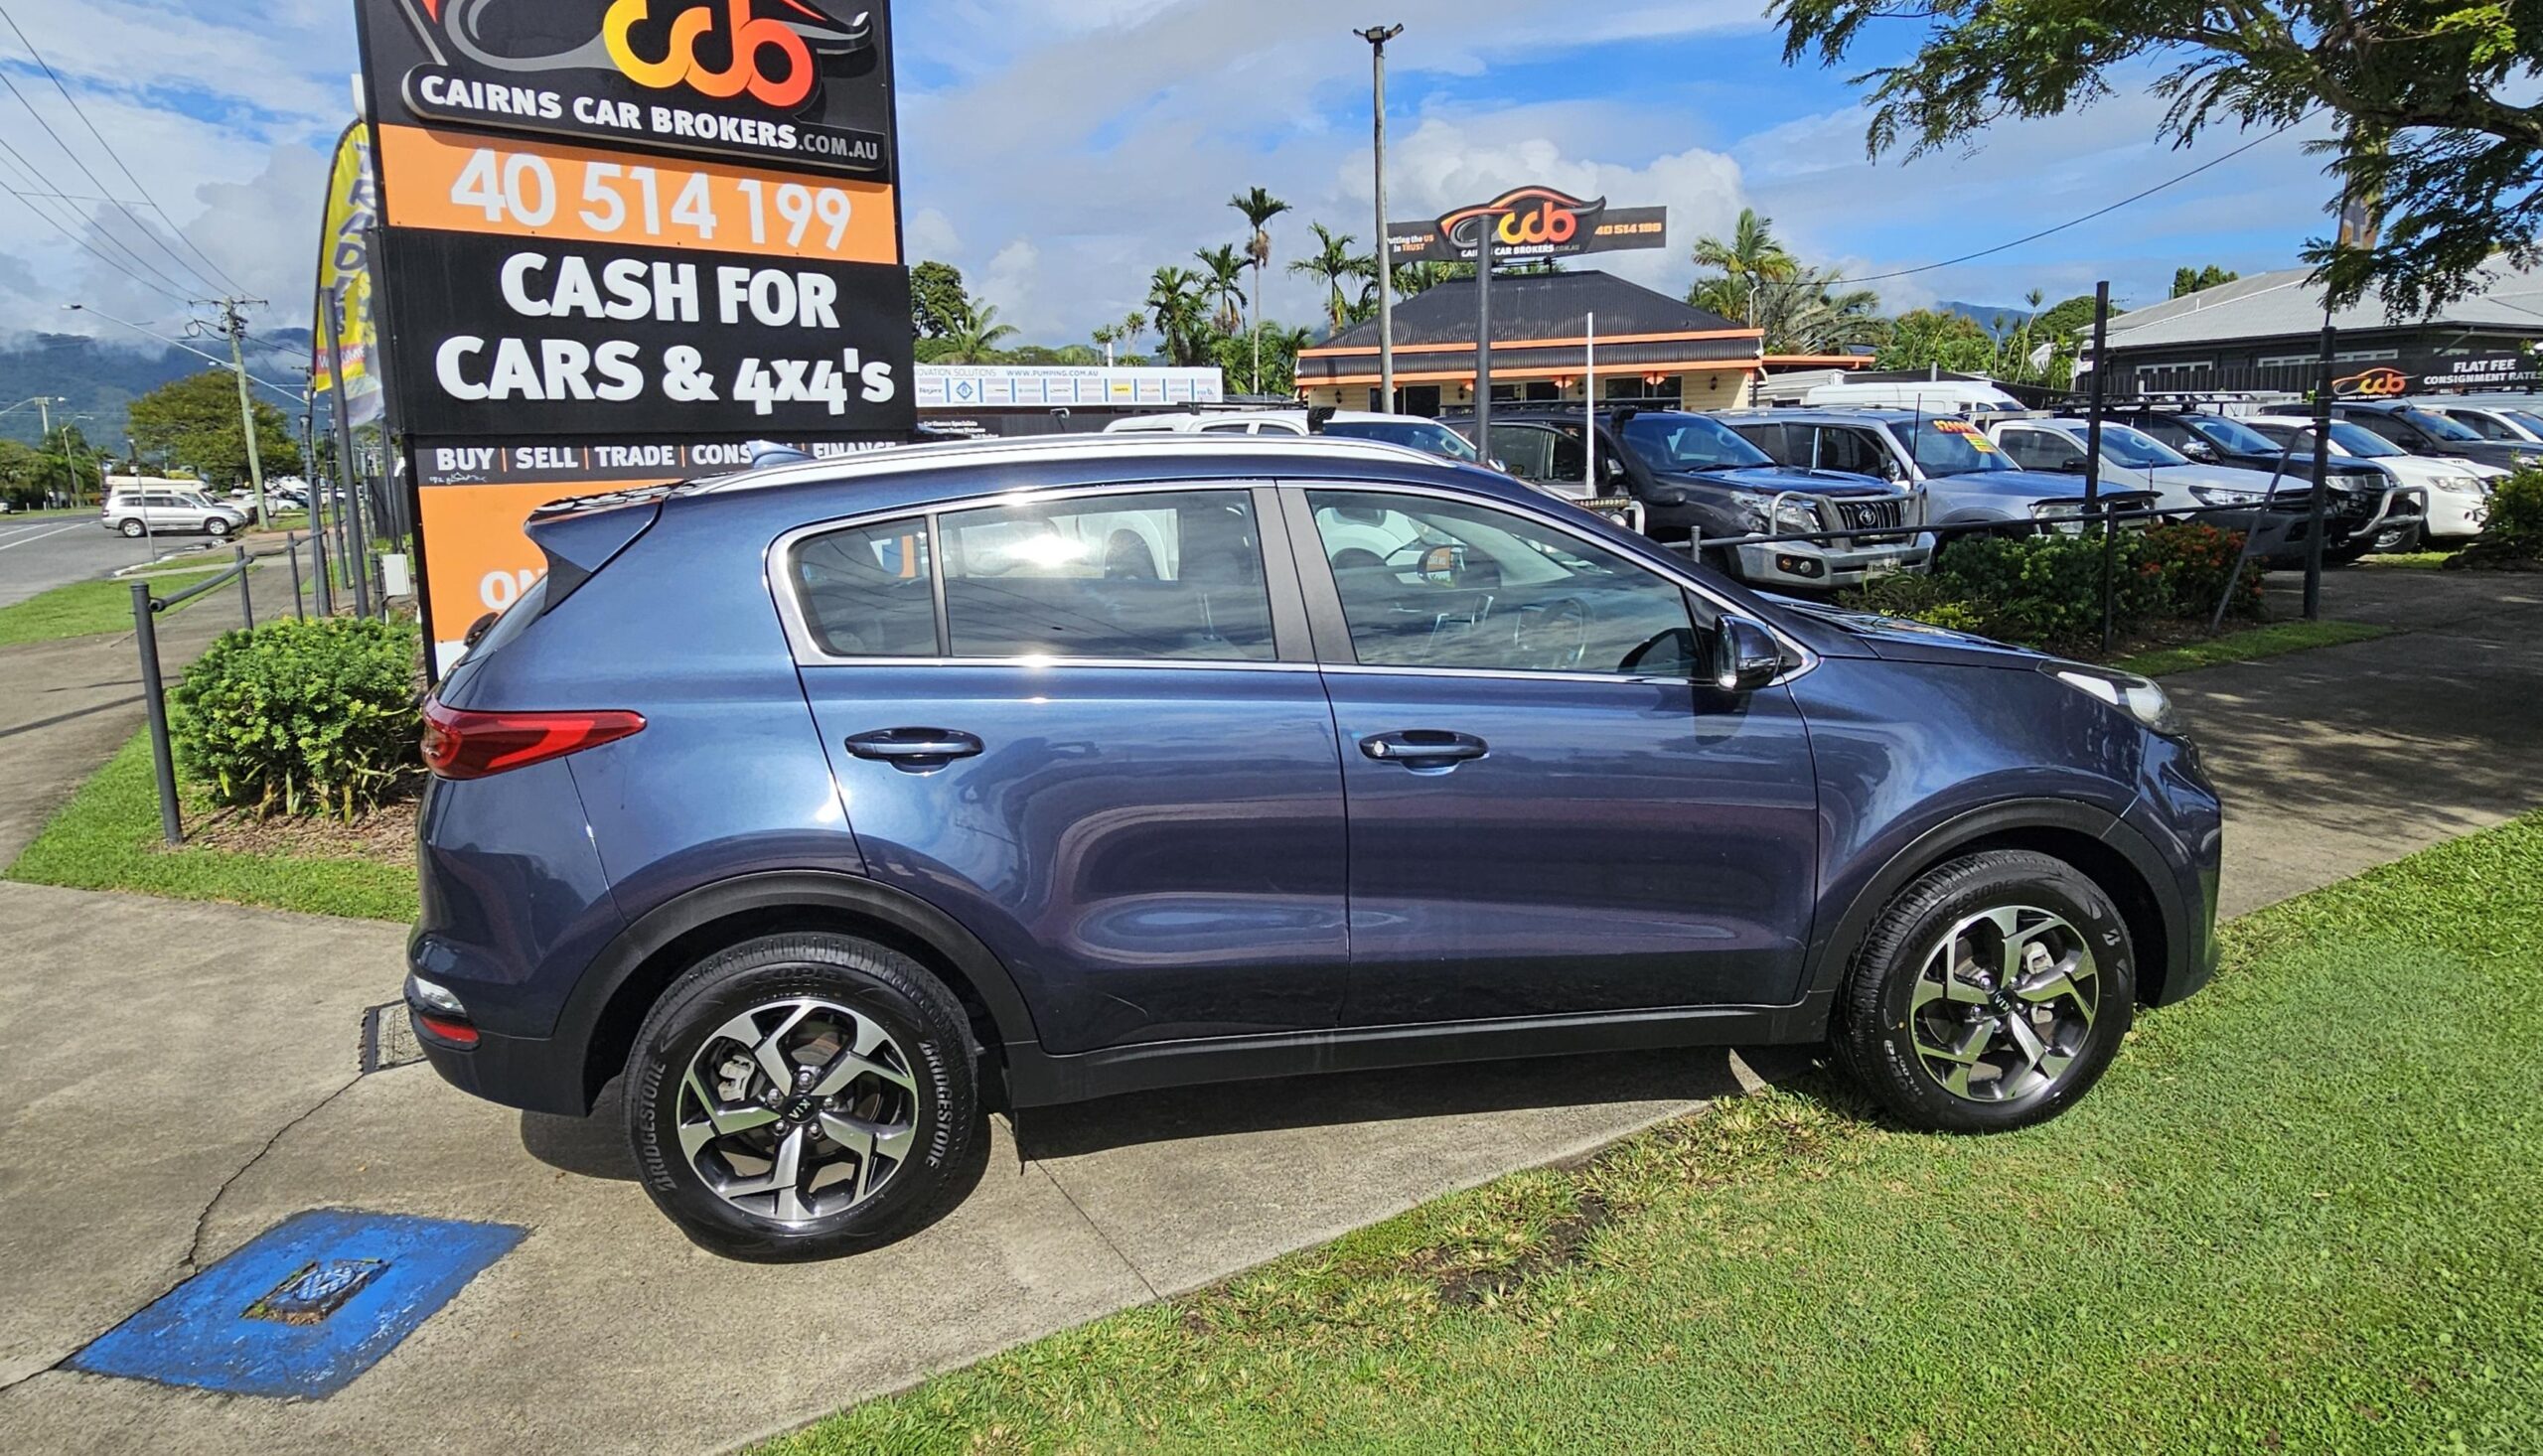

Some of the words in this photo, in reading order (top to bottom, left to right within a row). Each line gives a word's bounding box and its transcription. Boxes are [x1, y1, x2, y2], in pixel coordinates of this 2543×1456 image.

[420, 75, 562, 119] CAIRNS
[573, 96, 643, 130] CAR
[450, 147, 556, 227] 40
[578, 161, 718, 239] 514
[737, 179, 852, 251] 199
[1411, 234, 1422, 244] the
[1423, 233, 1434, 243] US
[1594, 224, 1612, 235] 40
[1614, 223, 1637, 234] 514
[1402, 243, 1425, 252] TRUST
[1494, 246, 1512, 256] CAR
[500, 252, 699, 323] CASH
[717, 265, 840, 330] FOR
[435, 336, 645, 400] CARS
[663, 345, 719, 402] &
[954, 368, 996, 377] SOLUTIONS
[2453, 361, 2488, 373] FLAT
[2490, 359, 2516, 371] FEE
[2424, 372, 2507, 385] CONSIGNMENT
[436, 447, 495, 472] BUY
[516, 446, 579, 470] SELL
[595, 444, 675, 469] TRADE
[813, 441, 896, 460] FINA
[788, 1098, 812, 1119] KIA
[917, 1039, 954, 1170] BRIDGESTONE
[640, 1058, 677, 1192] BRIDGESTONE
